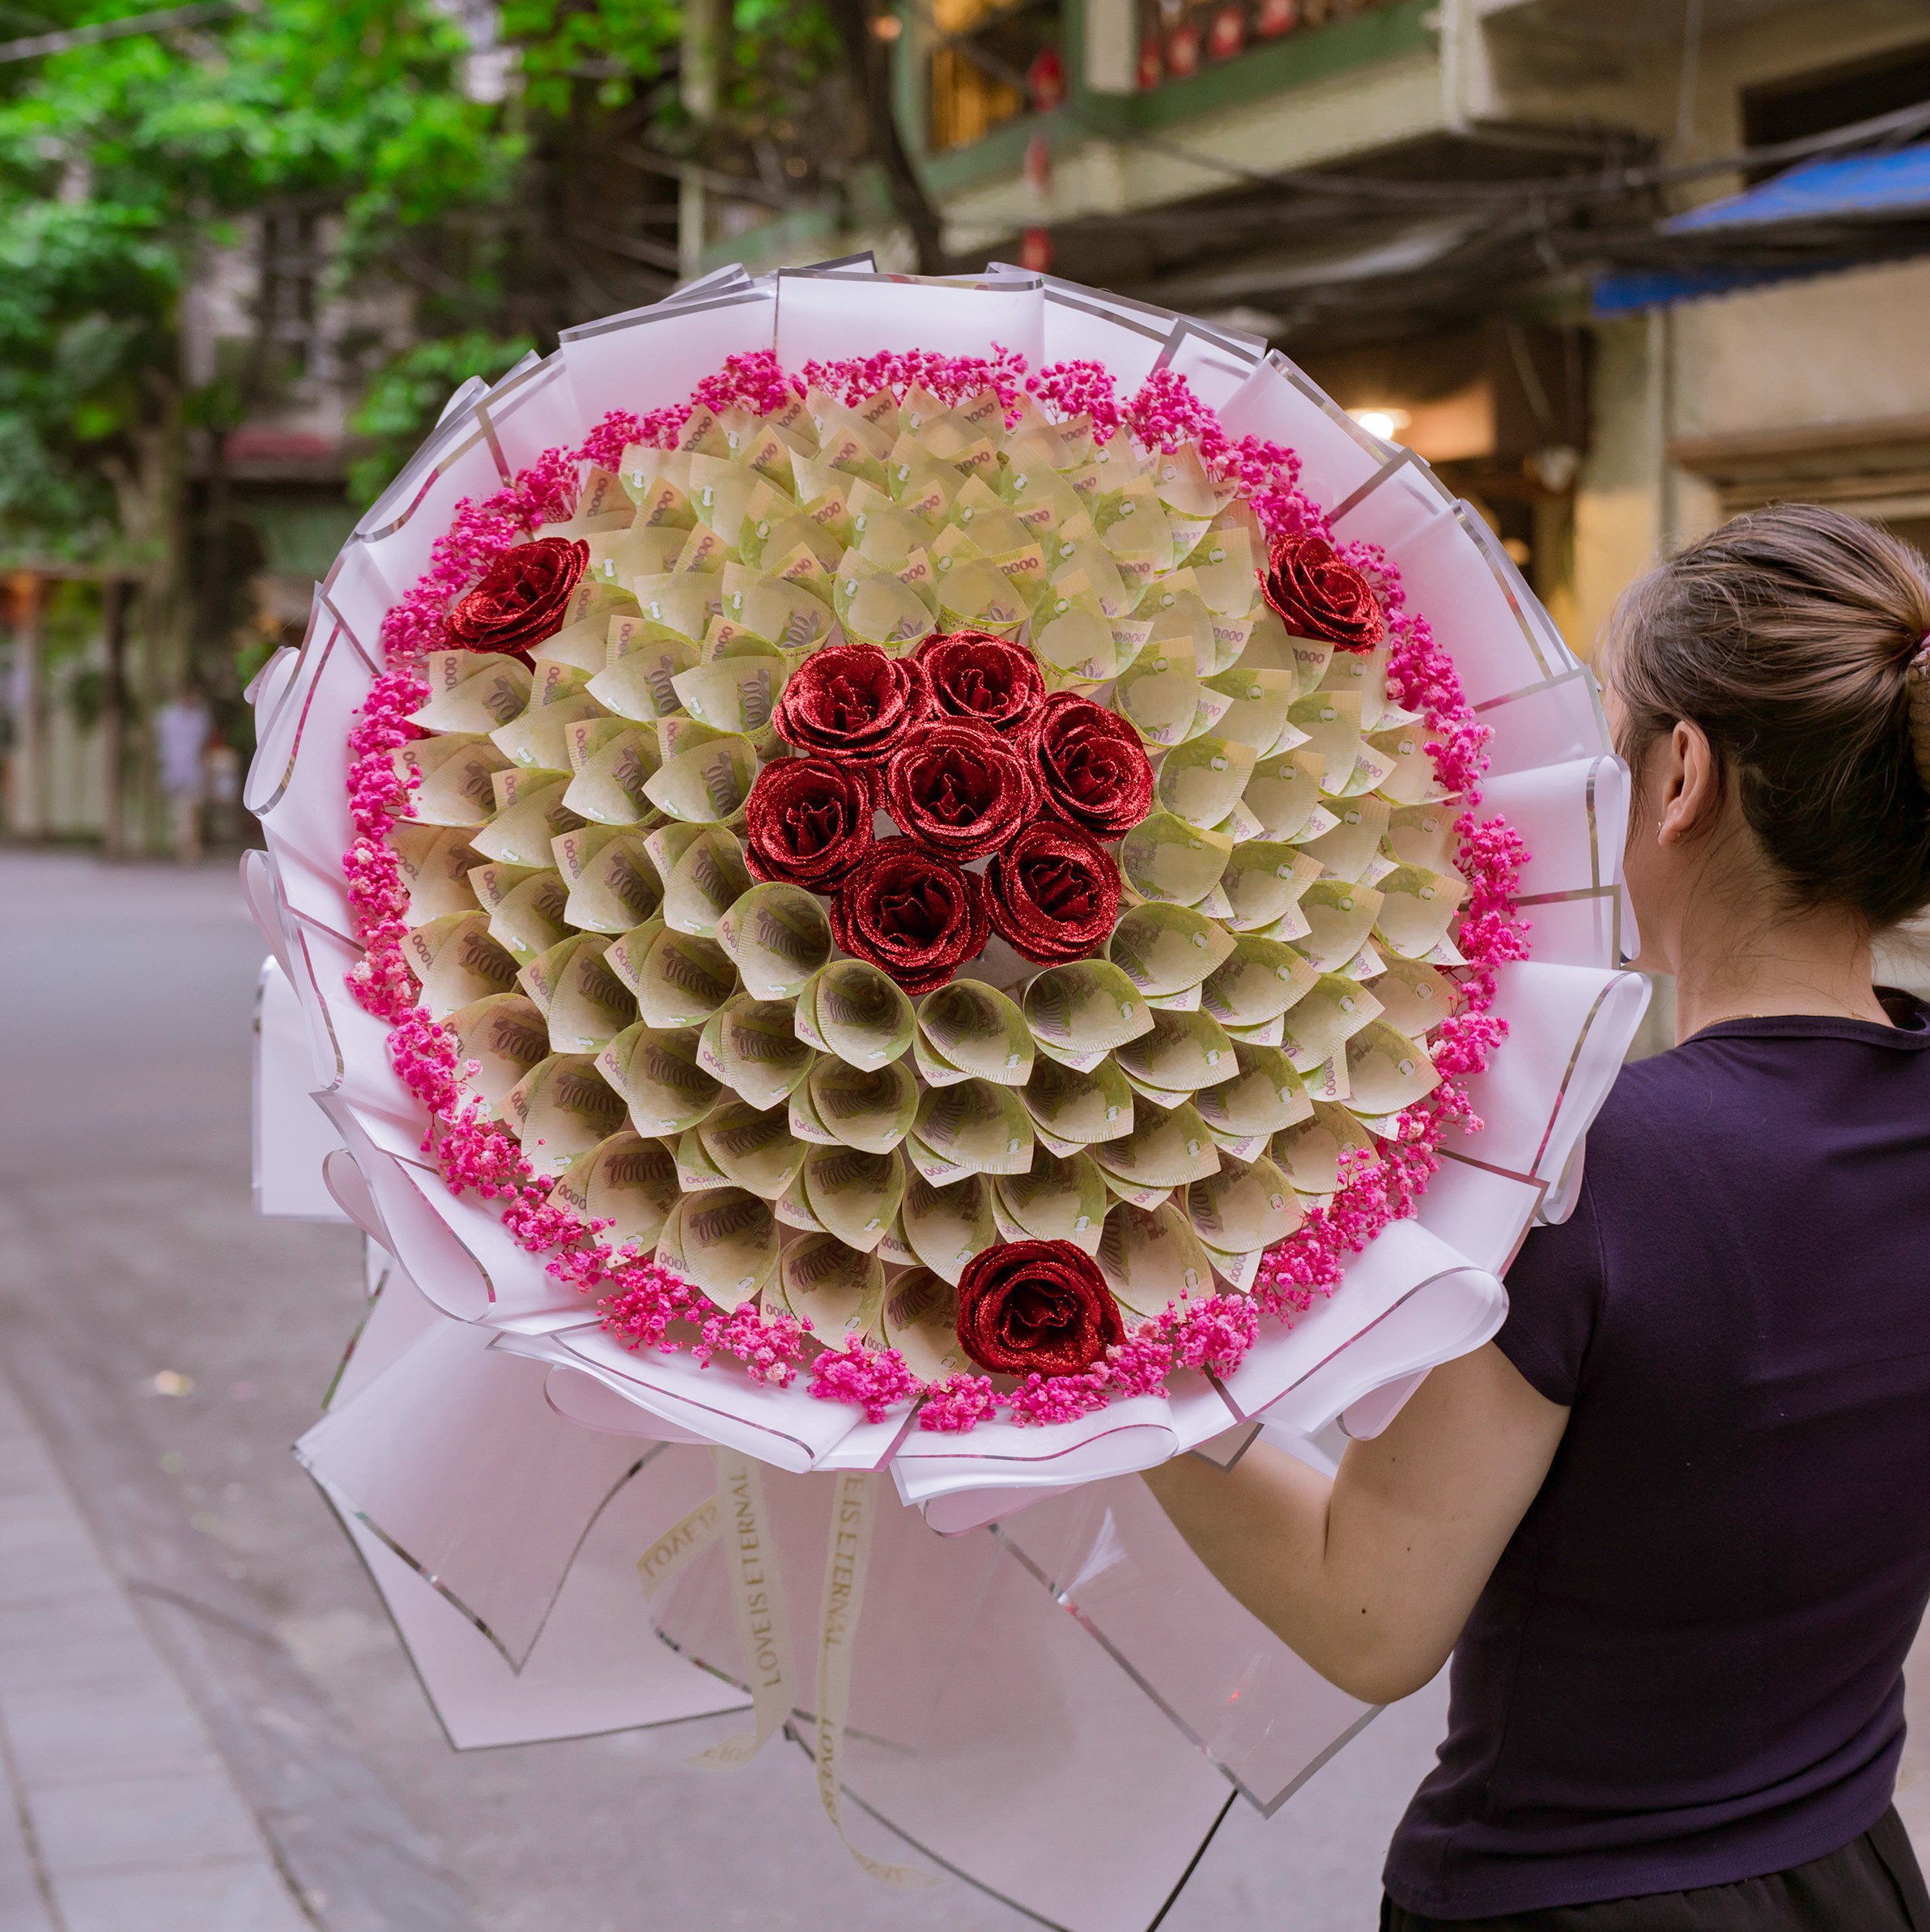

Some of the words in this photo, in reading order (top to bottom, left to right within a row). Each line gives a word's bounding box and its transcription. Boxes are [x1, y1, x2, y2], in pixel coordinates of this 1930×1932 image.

[729, 1466, 764, 1585] ETERNAL
[748, 1592, 768, 1615] IS
[751, 1619, 781, 1687] LOVE
